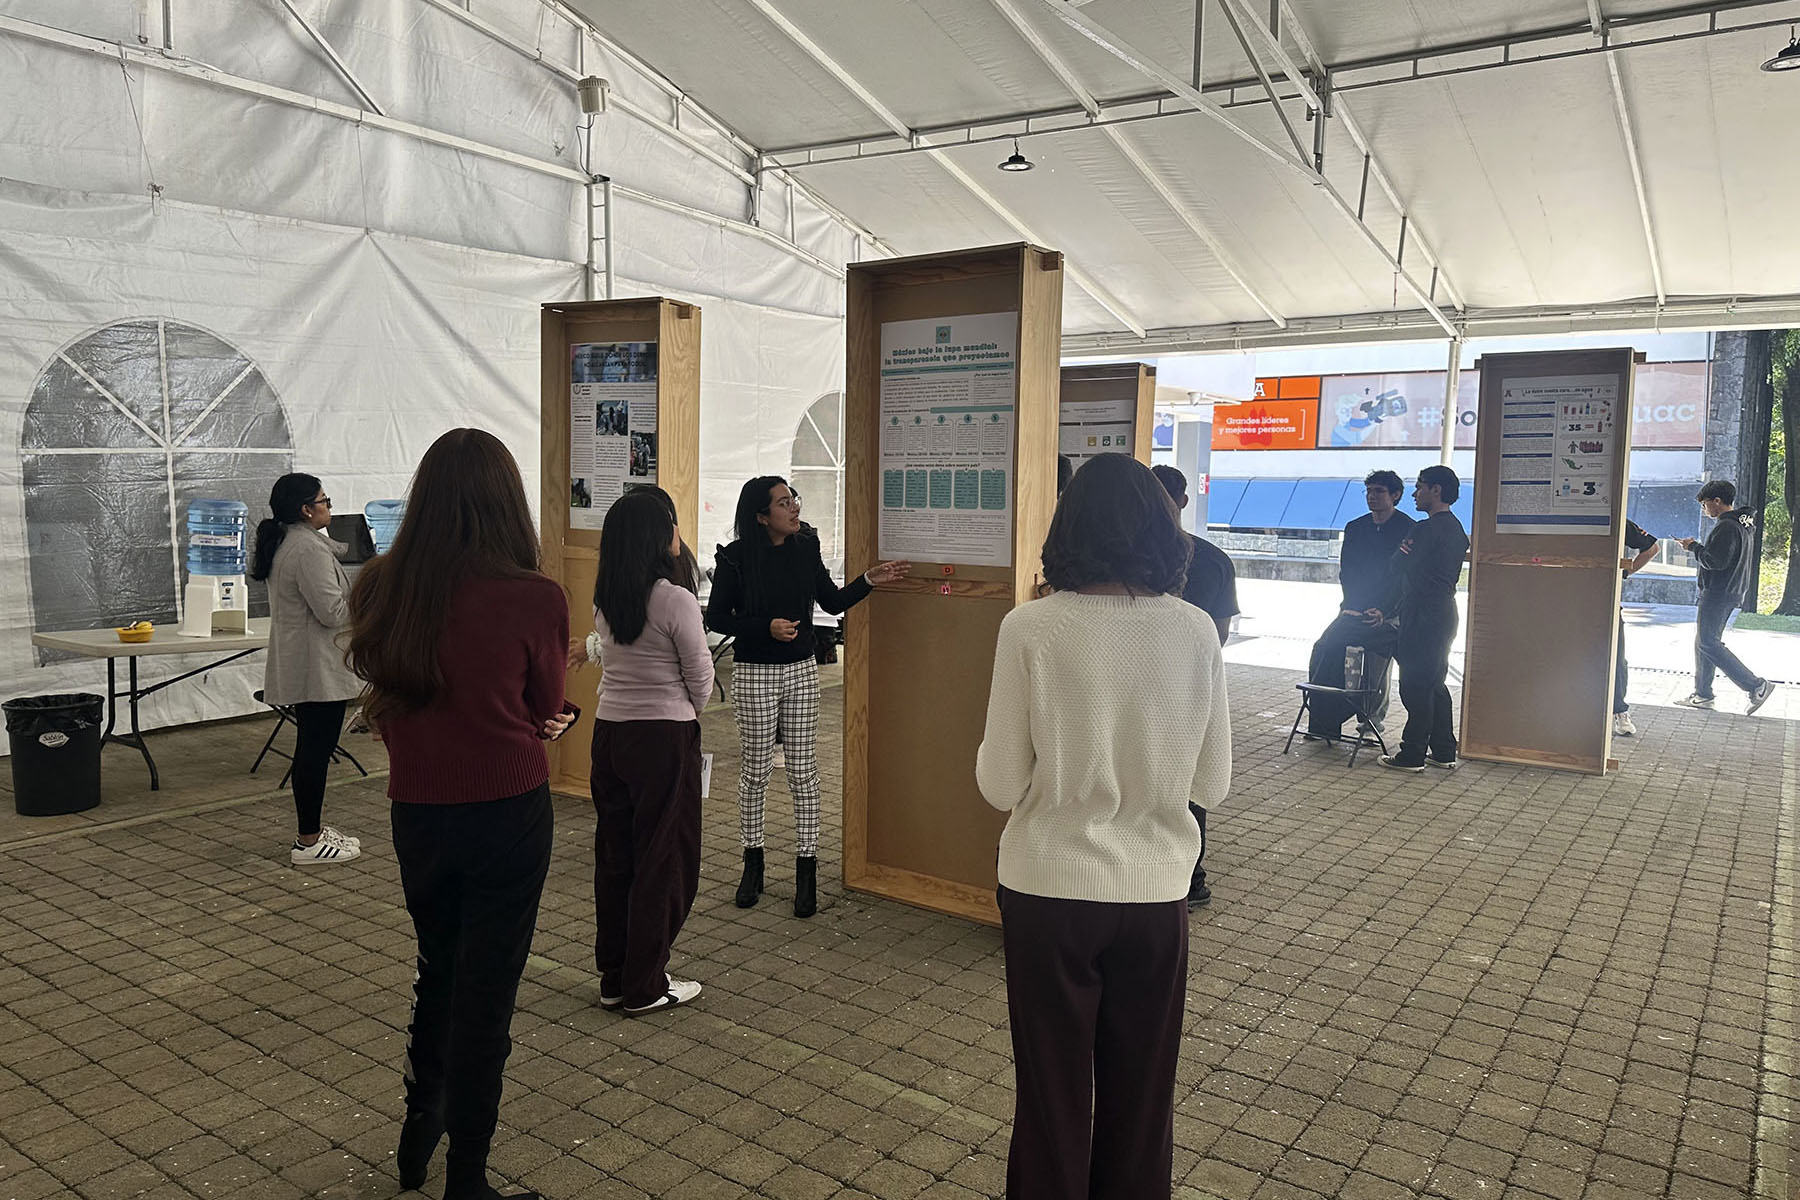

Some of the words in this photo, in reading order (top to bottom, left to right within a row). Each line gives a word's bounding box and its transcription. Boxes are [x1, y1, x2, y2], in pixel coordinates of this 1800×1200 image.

[893, 355, 941, 365] transparencia
[1254, 382, 1265, 397] A
[1258, 426, 1296, 435] personas
[1583, 481, 1596, 496] 3
